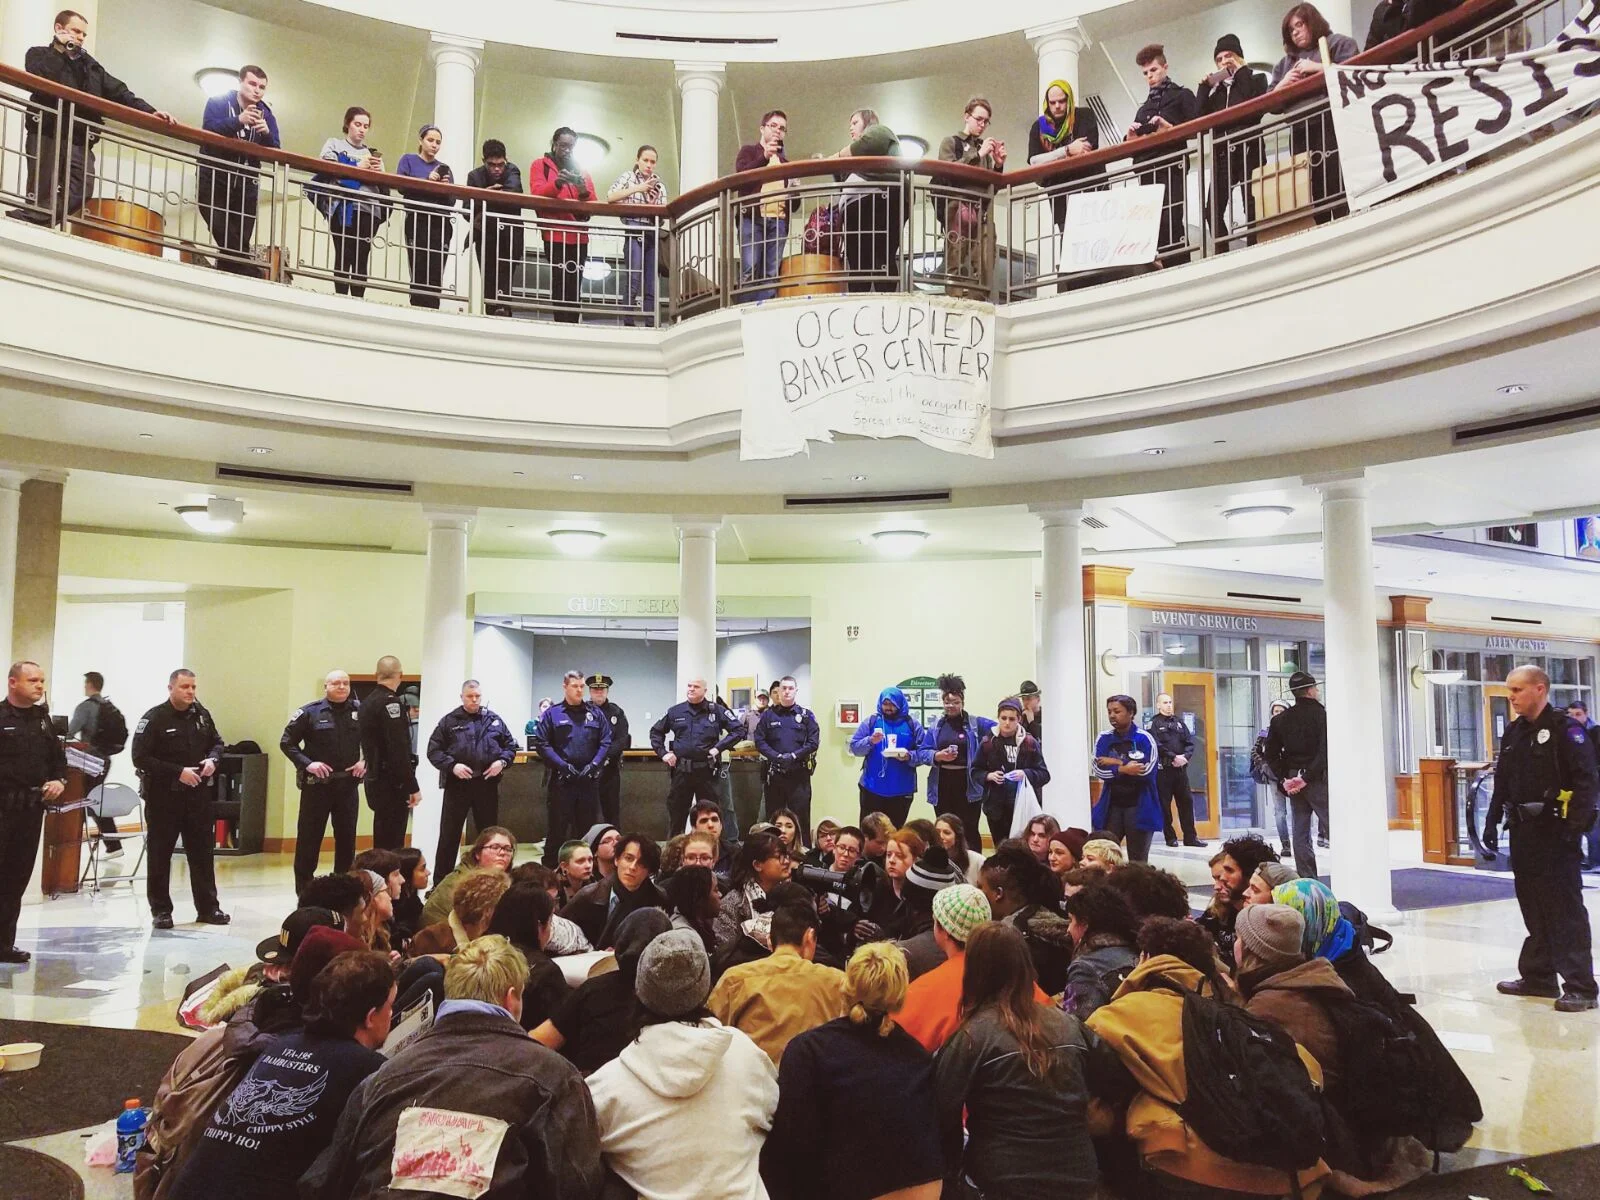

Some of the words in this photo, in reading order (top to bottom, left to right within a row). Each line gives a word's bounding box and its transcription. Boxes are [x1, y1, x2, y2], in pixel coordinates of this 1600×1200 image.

[796, 305, 985, 348] OCCUPIED
[780, 343, 874, 403] BAKER
[883, 337, 989, 382] CENTER
[567, 597, 630, 614] GUEST
[1152, 610, 1197, 627] EVENT
[1200, 615, 1258, 631] SERVICES
[1484, 636, 1515, 650] ALLEN
[1517, 638, 1550, 652] CENTER
[262, 1055, 321, 1074] DAMBUSTERS
[246, 1123, 283, 1135] CHIPPY
[285, 1112, 317, 1131] STYLE
[203, 1127, 235, 1146] CHIPPY
[235, 1133, 261, 1150] HO!
